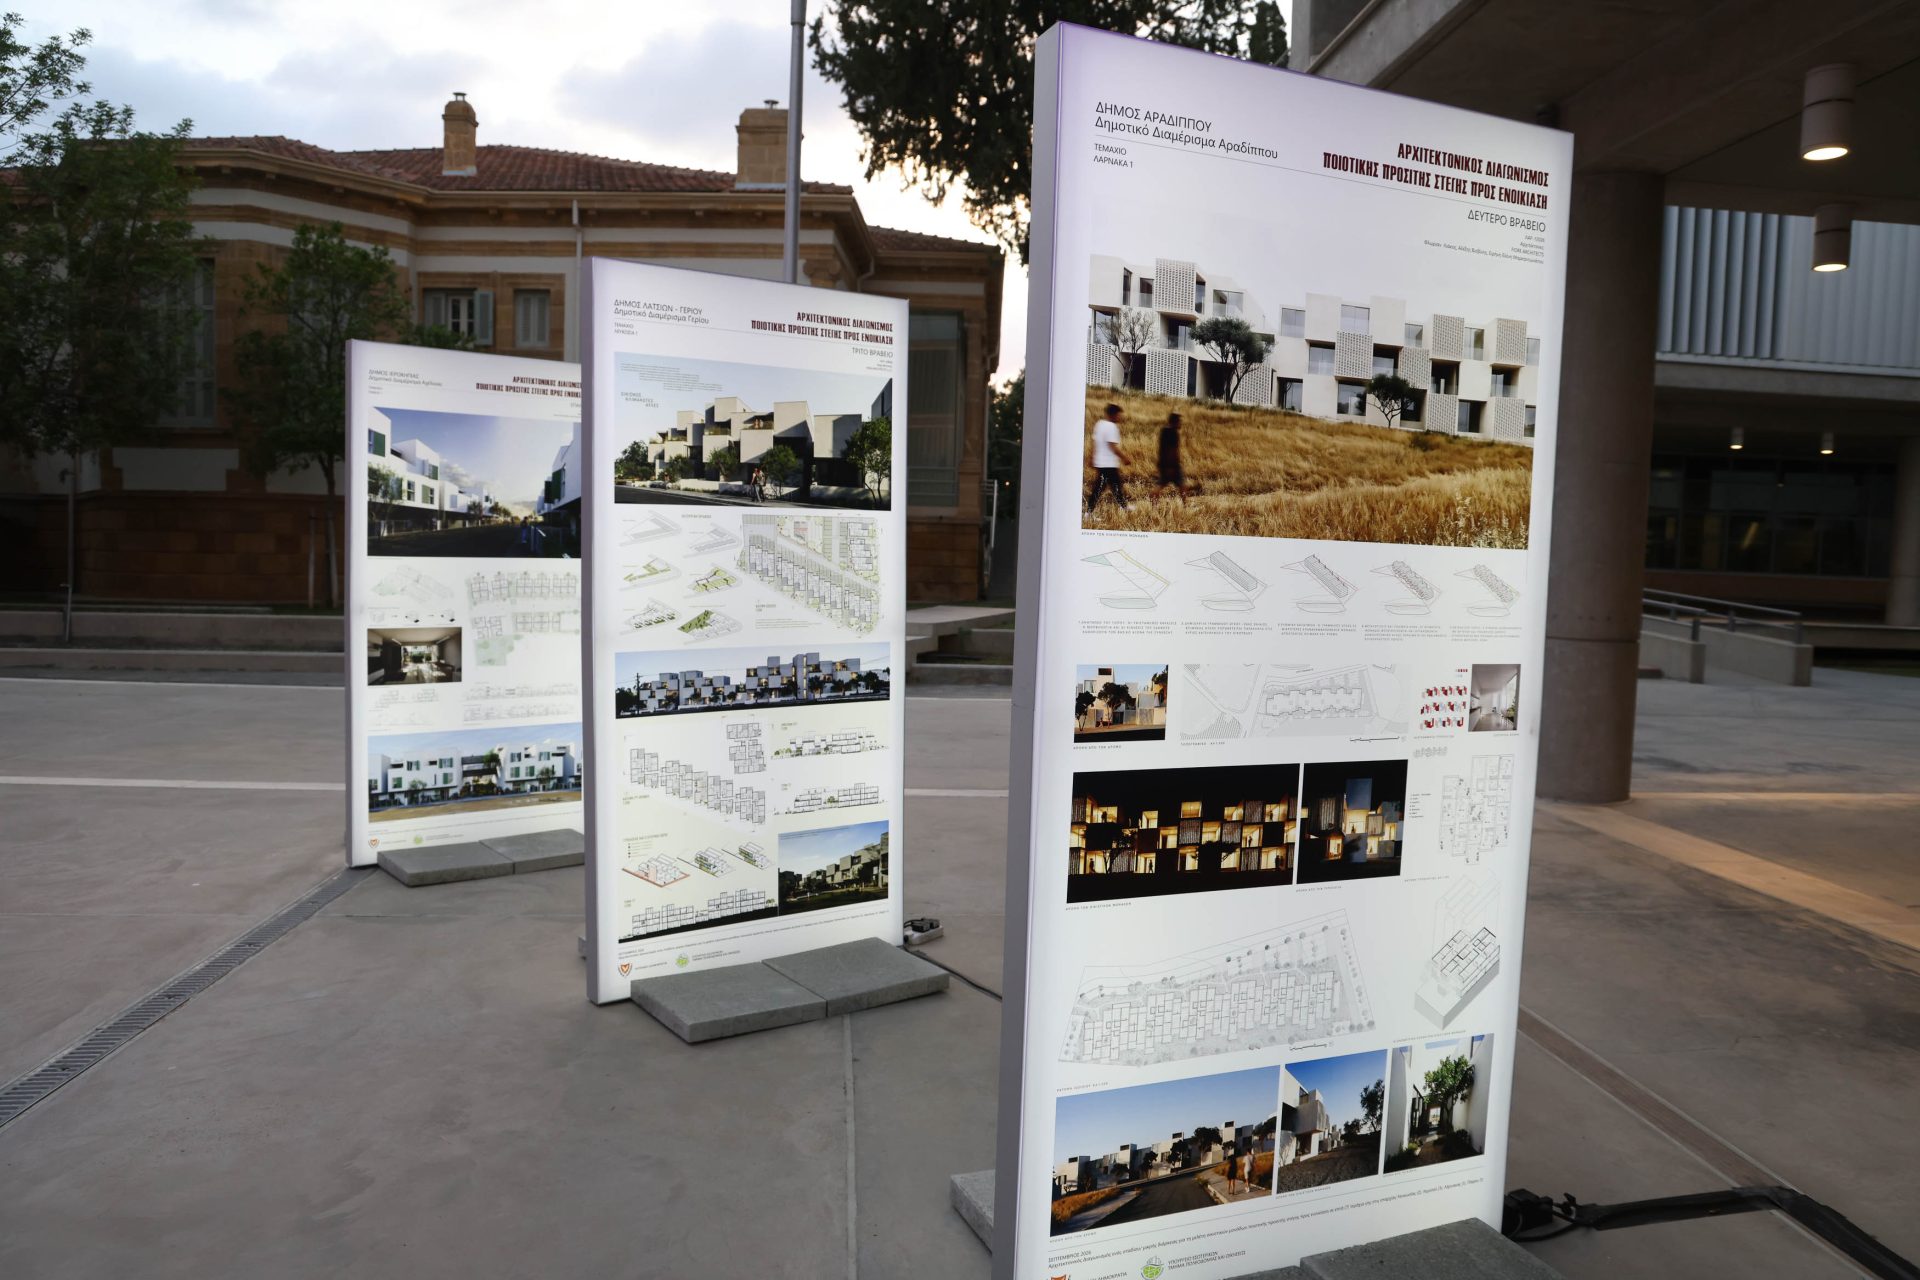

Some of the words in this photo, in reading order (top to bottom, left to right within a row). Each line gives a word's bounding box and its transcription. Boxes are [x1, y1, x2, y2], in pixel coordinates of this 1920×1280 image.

[1096, 102, 1140, 120] ΔΗΜΟΣ
[1144, 110, 1212, 132] ΑΡΑΔΙΠΠΟΥ
[1095, 116, 1149, 136] Δημοτικό
[1153, 127, 1216, 148] Διαμέρισμα
[1219, 138, 1278, 159] Αραδίππου
[1094, 144, 1127, 155] ΤΕΜΑΧΙΟ
[1094, 155, 1128, 167] ΛΑΡΝΑΚΑ
[1398, 143, 1483, 174] ΑΡΧΙΤΕΚΤΟΝΙΚΟΣ
[1486, 161, 1549, 187] ΔΙΑΓΩΝΙΣΜΟΣ
[1323, 152, 1379, 178] ΠΟΙΟΤΙΚΗΣ
[1382, 164, 1431, 188] ΠΡΟΣΙΤΗΣ
[1434, 174, 1467, 194] ΣΤΕΓΗΣ
[1470, 181, 1496, 200] ΠΡΟΣ
[1498, 187, 1548, 210] ΕΝΟΙΚΙΑΣΗ
[1468, 209, 1507, 226] ΔΕΥΤΕΡΟ
[1510, 217, 1546, 233] ΒΡΑΒΕΙΟ
[614, 300, 640, 308] ΔΗΜΟΣ
[643, 303, 673, 312] ΛΑΤΣΙΩΝ
[680, 307, 702, 315] ΓΕΡΙΟΥ
[614, 307, 646, 317] Δημοτικό
[648, 311, 686, 322] Διαμέρισμα
[688, 315, 709, 324] Γερίου
[751, 320, 786, 333] ΠΟΙΟΤΙΚΗΣ
[788, 324, 819, 337] ΠΡΟΣΙΤΗΣ
[820, 328, 842, 339] ΣΤΕΓΗΣ
[844, 331, 860, 341] ΠΡΟΣ
[861, 333, 893, 345] ΕΝΟΙΚΙΑΣΗ
[797, 312, 850, 327] ΑΡΧΙΤΕΚΤΟΝΙΚΟΣ
[853, 319, 893, 332] ΔΙΑΓΩΝΙΣΜΟΣ
[852, 347, 868, 355] ΤΡΙΤΟ
[870, 349, 893, 358] ΒΡΑΒΕΙΟ
